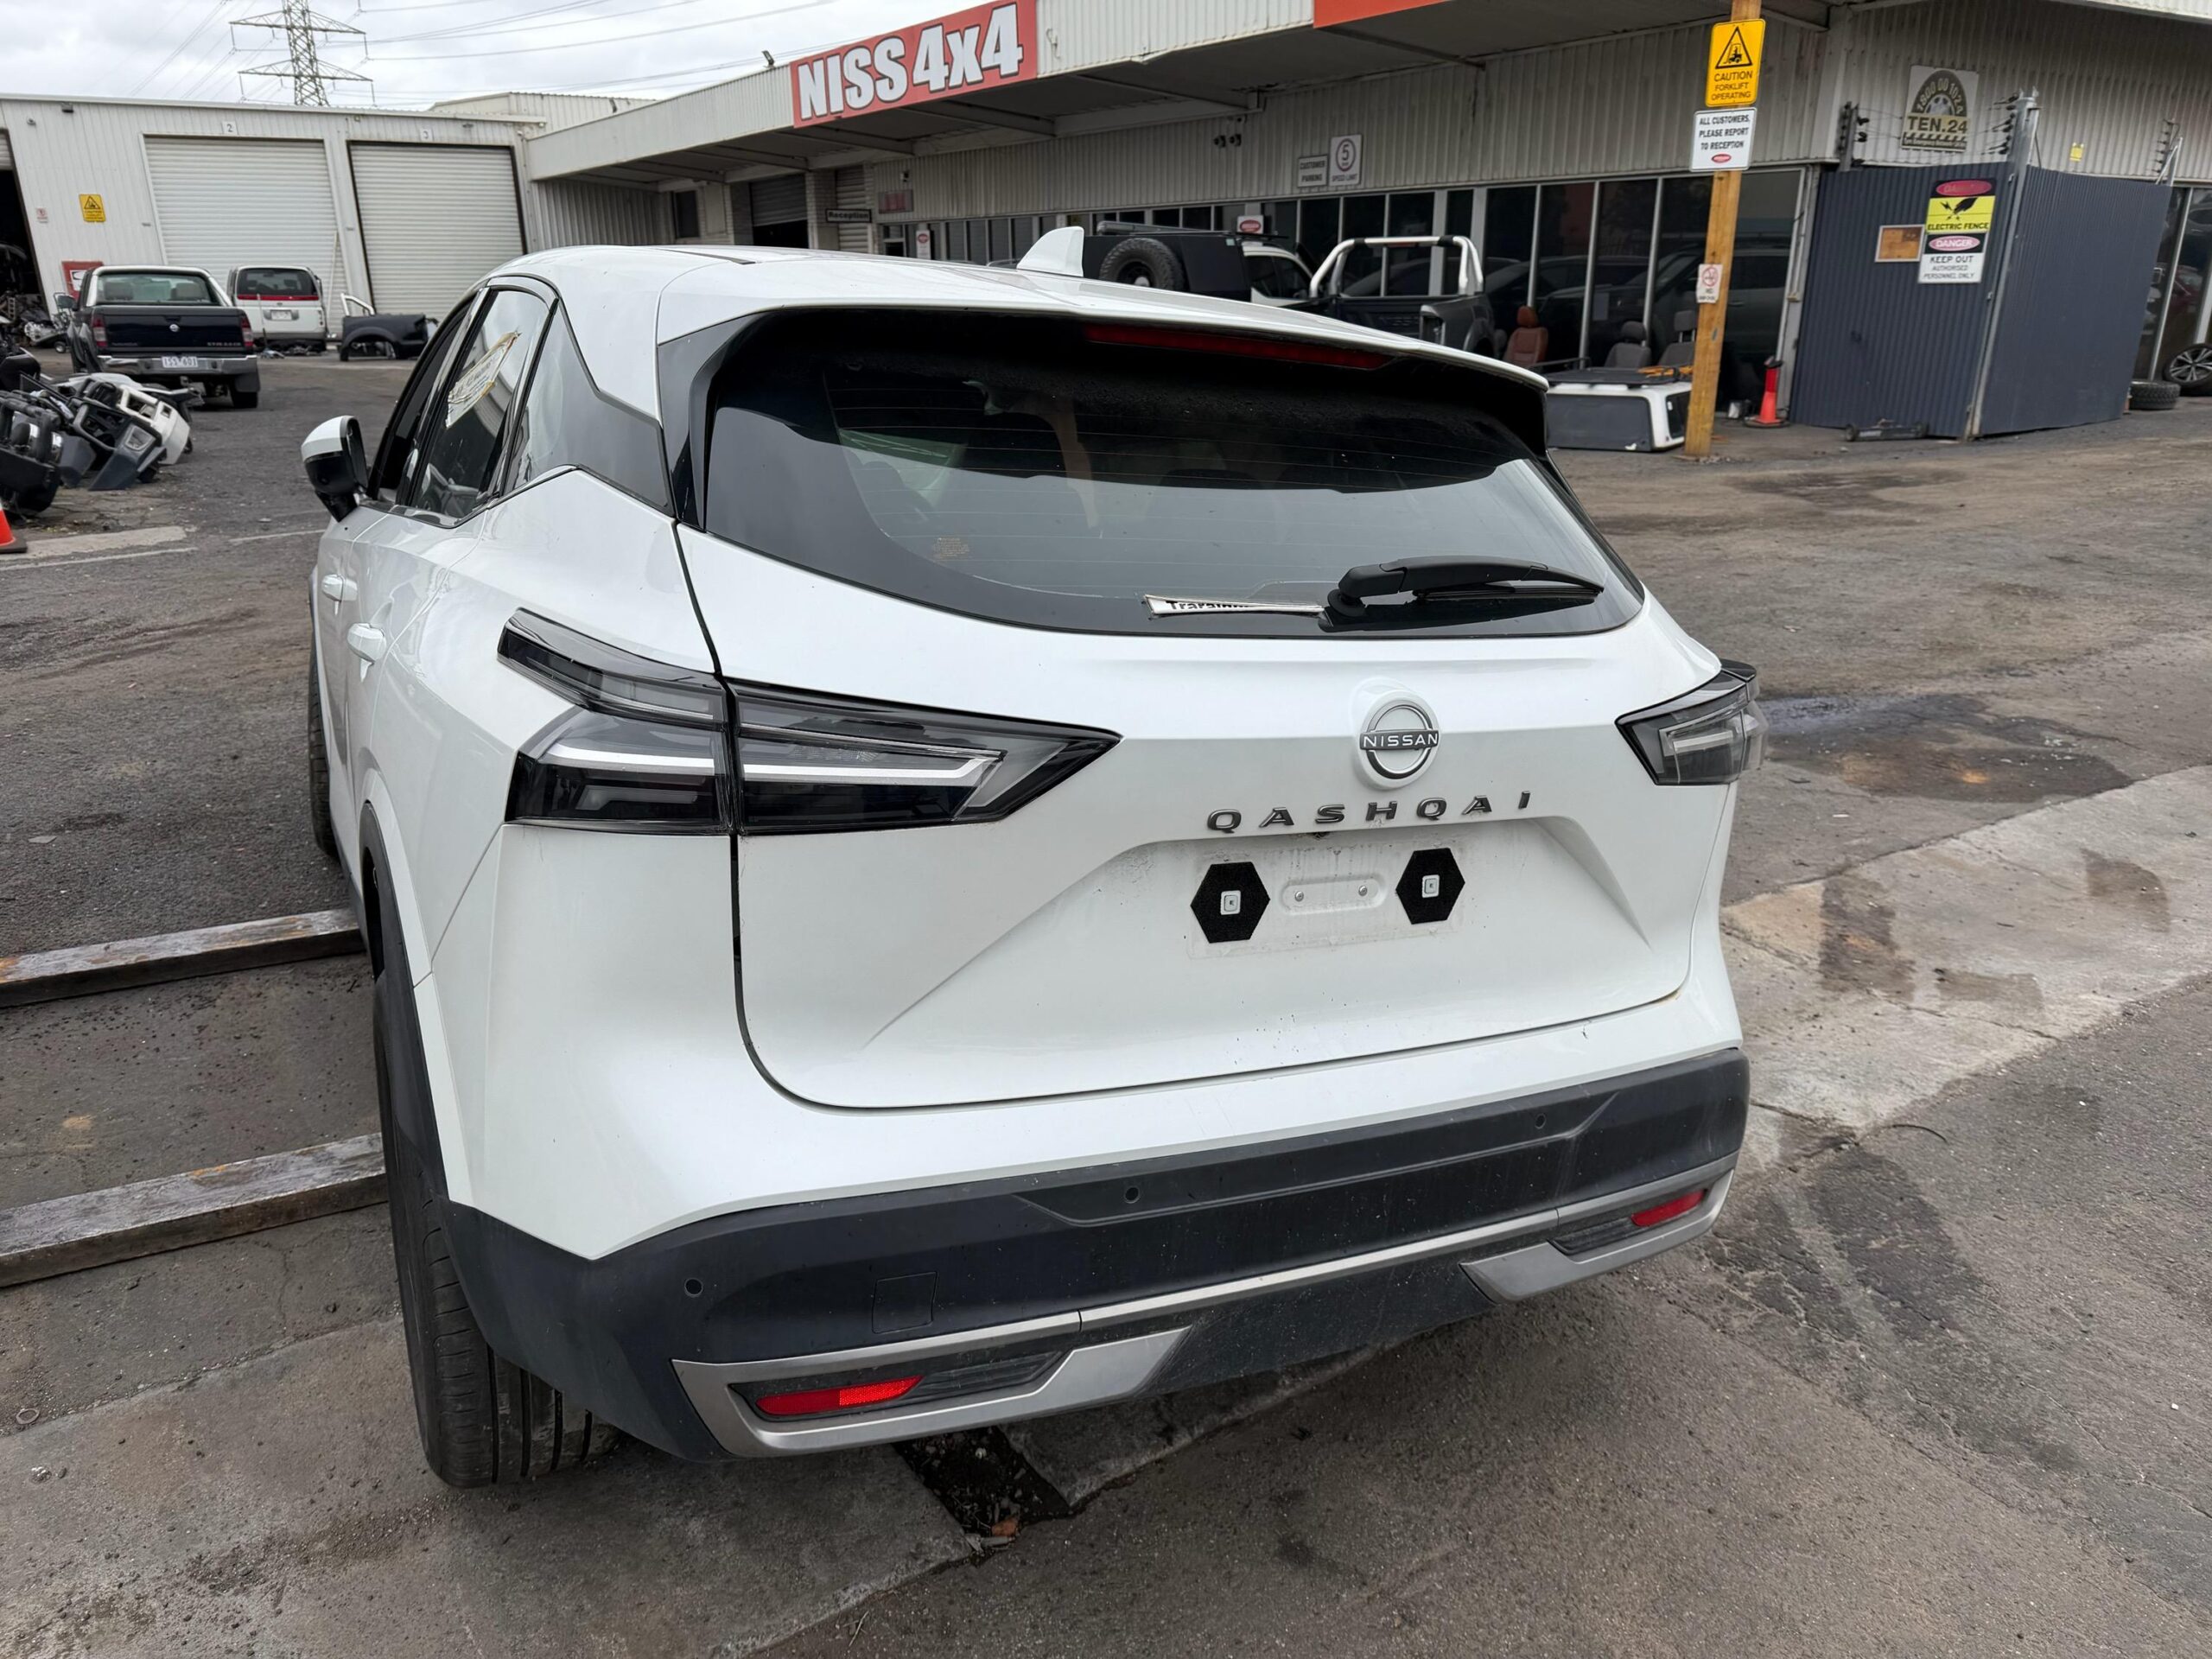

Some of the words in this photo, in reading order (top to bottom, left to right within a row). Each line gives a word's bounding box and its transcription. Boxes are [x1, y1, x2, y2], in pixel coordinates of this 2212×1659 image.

[1713, 71, 1753, 82] CAUTION
[1715, 82, 1749, 92] FORKLIFT
[1711, 91, 1751, 101] OPERATING
[226, 124, 233, 133] 2
[1907, 116, 1967, 134] TEN.24
[1699, 129, 1723, 138] PLEASE
[1724, 127, 1750, 137] REPORT
[1710, 141, 1744, 150] RECEPTION
[1341, 143, 1350, 161] 5
[1299, 160, 1325, 170] CUSTOMER
[1301, 174, 1322, 183] PARKING
[829, 211, 868, 219] Reception
[1363, 732, 1439, 747] NISSAN
[1207, 790, 1530, 834] QASHQAI
